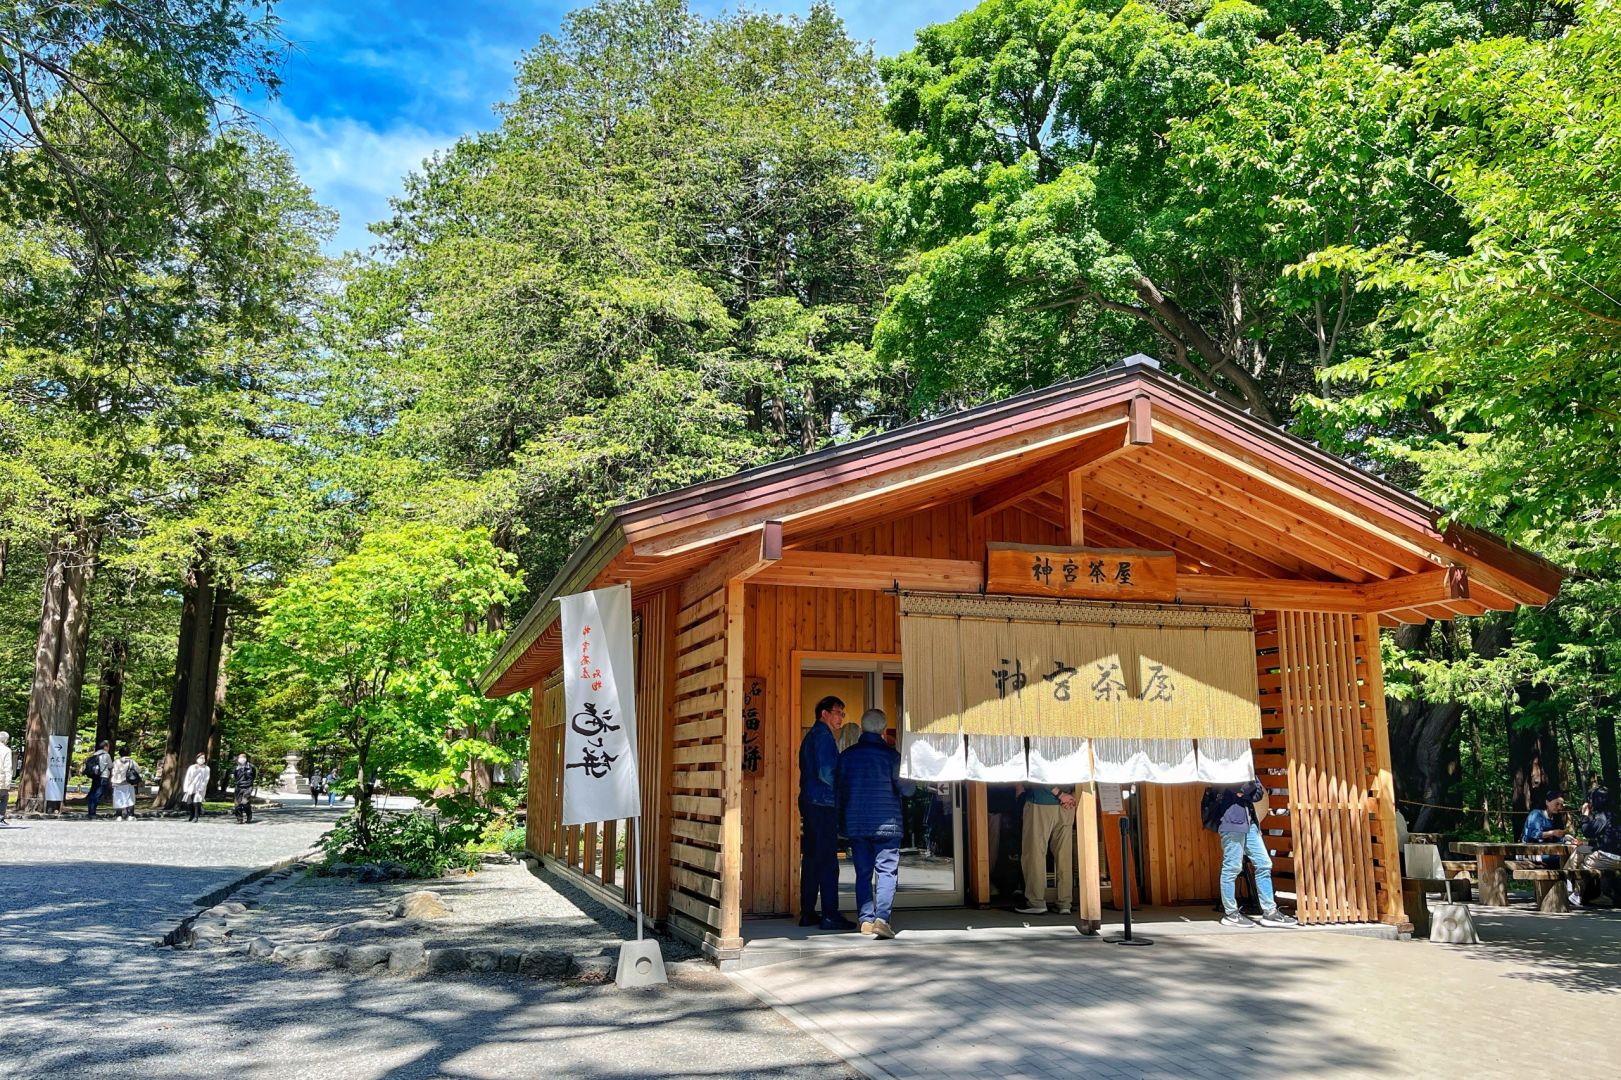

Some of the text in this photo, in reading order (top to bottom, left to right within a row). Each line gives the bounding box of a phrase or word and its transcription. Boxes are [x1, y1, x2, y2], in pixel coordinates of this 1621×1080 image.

[1032, 556, 1134, 586] 神宮茶屋
[992, 657, 1175, 701] 神宮茶屋
